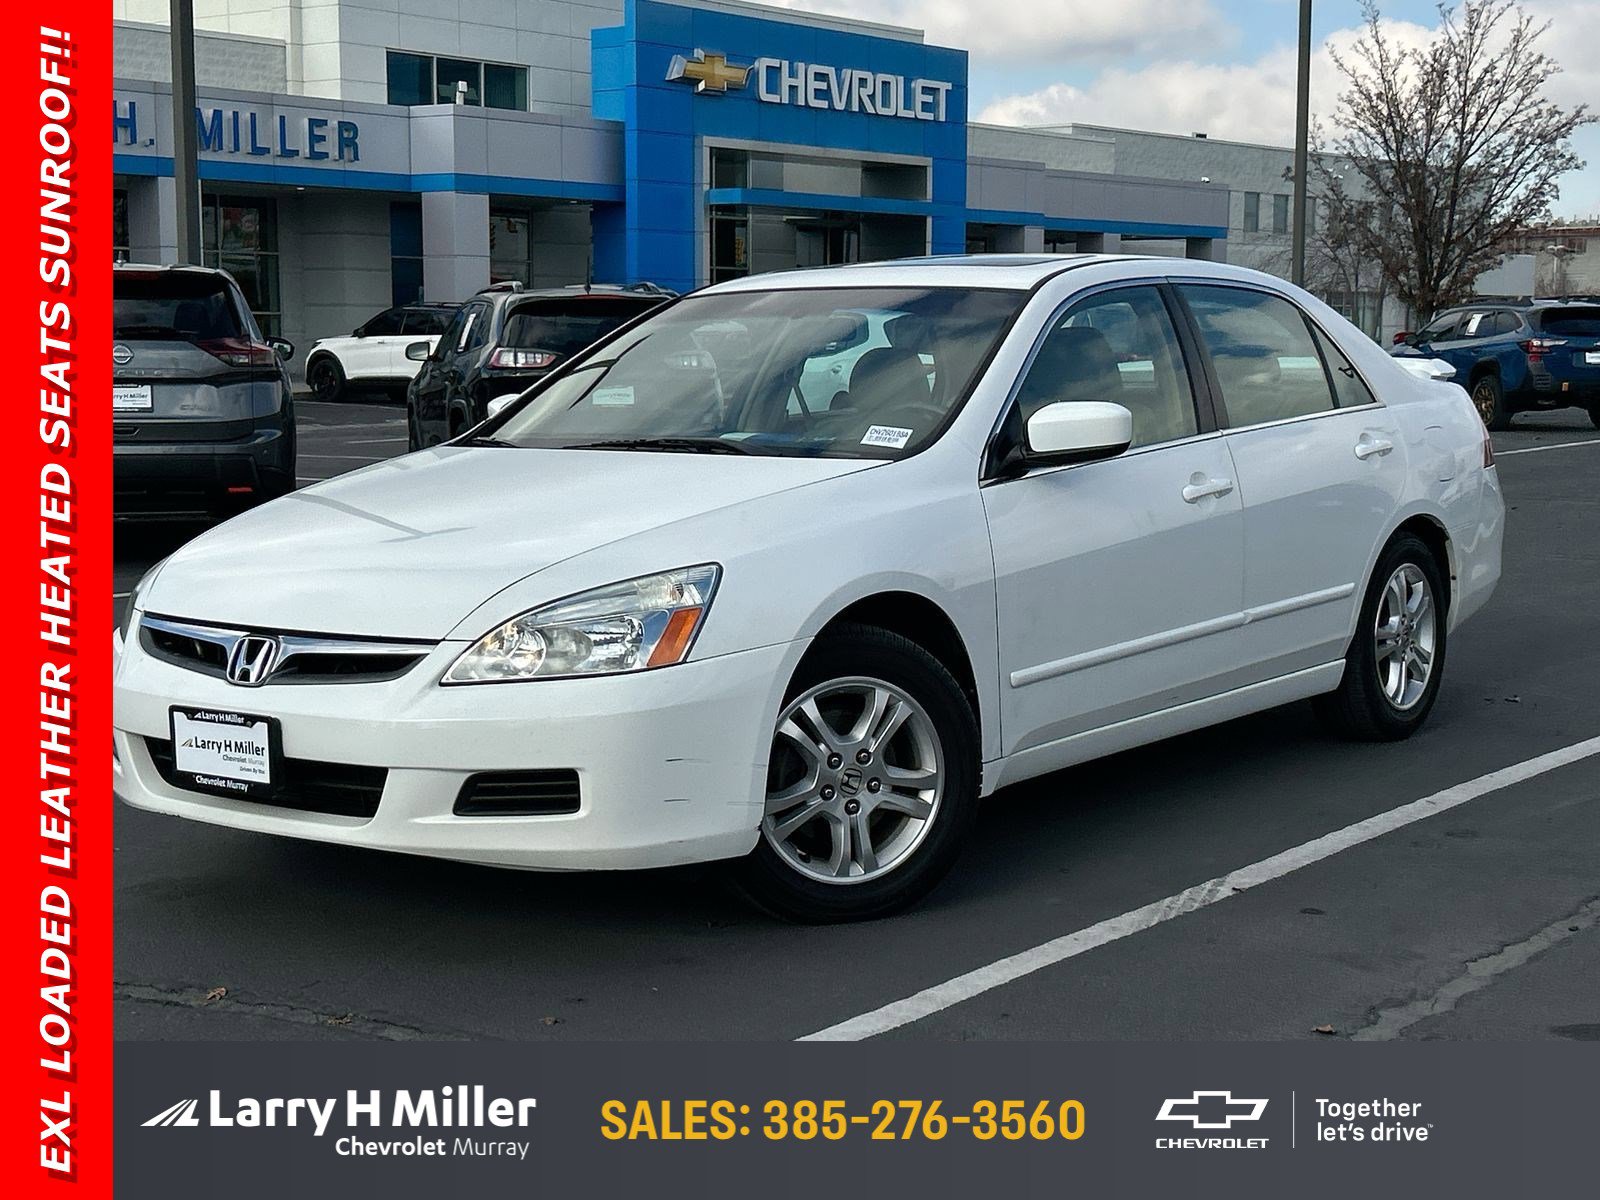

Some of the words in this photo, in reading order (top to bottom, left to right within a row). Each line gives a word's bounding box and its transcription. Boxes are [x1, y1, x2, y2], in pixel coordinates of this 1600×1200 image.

[757, 56, 952, 122] CHEVROLET
[195, 106, 360, 163] MILLER
[194, 736, 222, 754] Larry
[224, 740, 233, 752] H
[234, 741, 265, 757] Miller
[195, 775, 226, 787] Chevrolet
